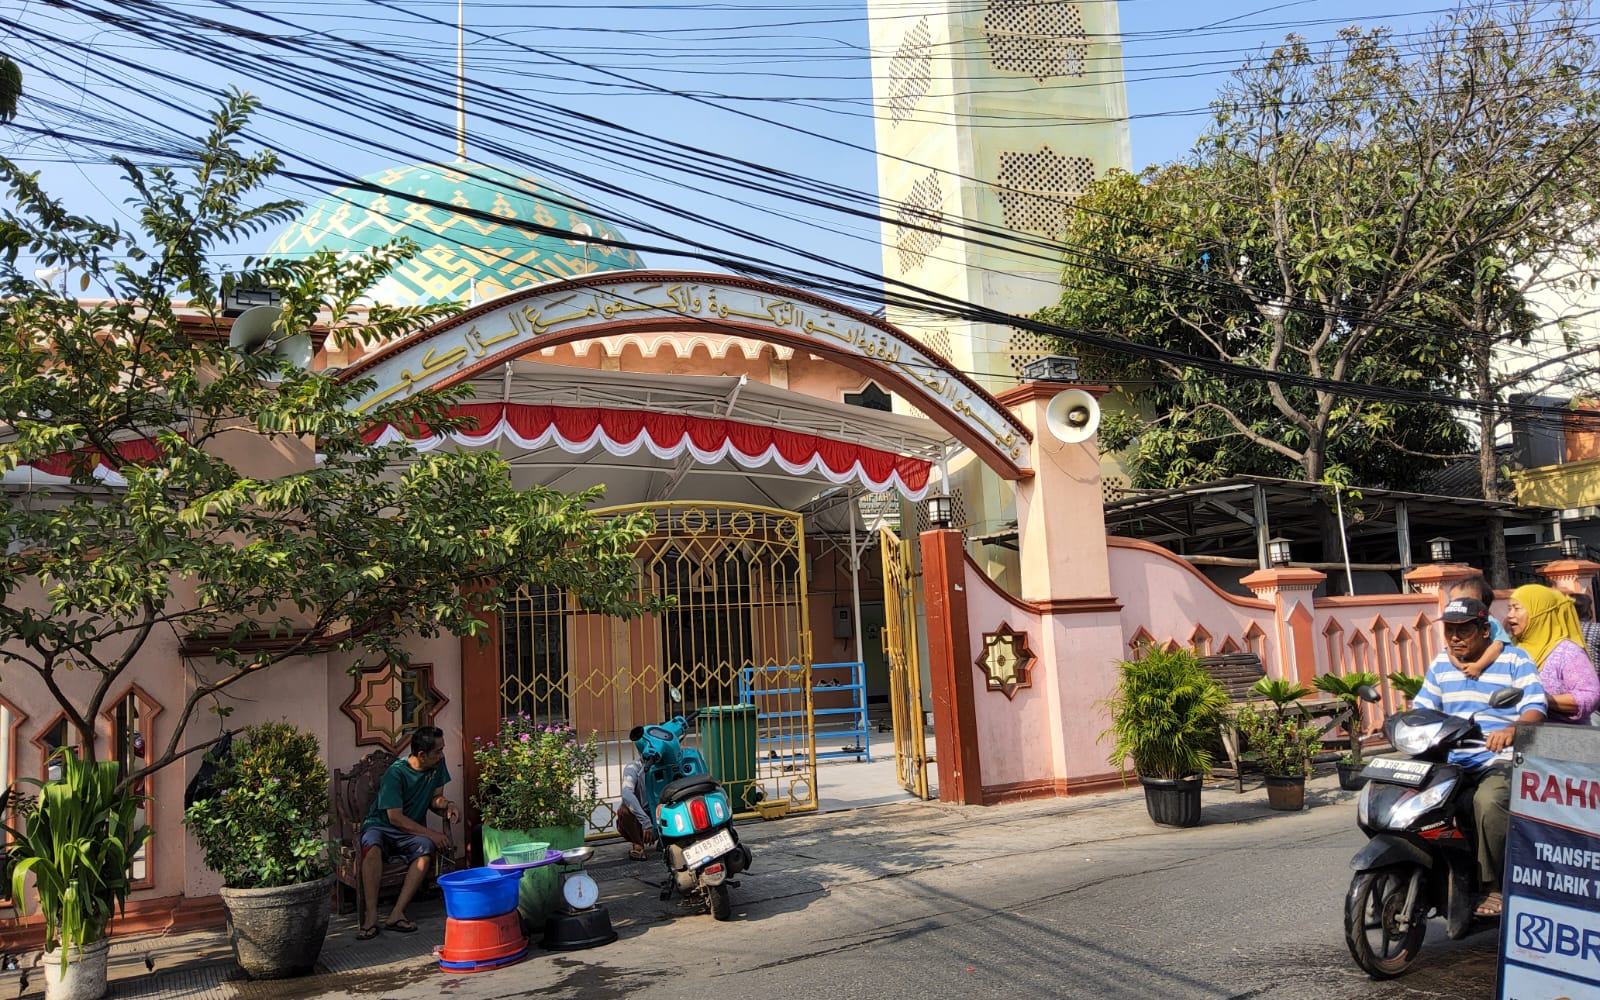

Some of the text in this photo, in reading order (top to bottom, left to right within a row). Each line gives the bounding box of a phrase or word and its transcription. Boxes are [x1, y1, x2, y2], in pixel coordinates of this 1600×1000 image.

[1534, 842, 1600, 870] TRANSFE
[1512, 865, 1542, 887] DAN
[1546, 871, 1590, 896] TARIK
